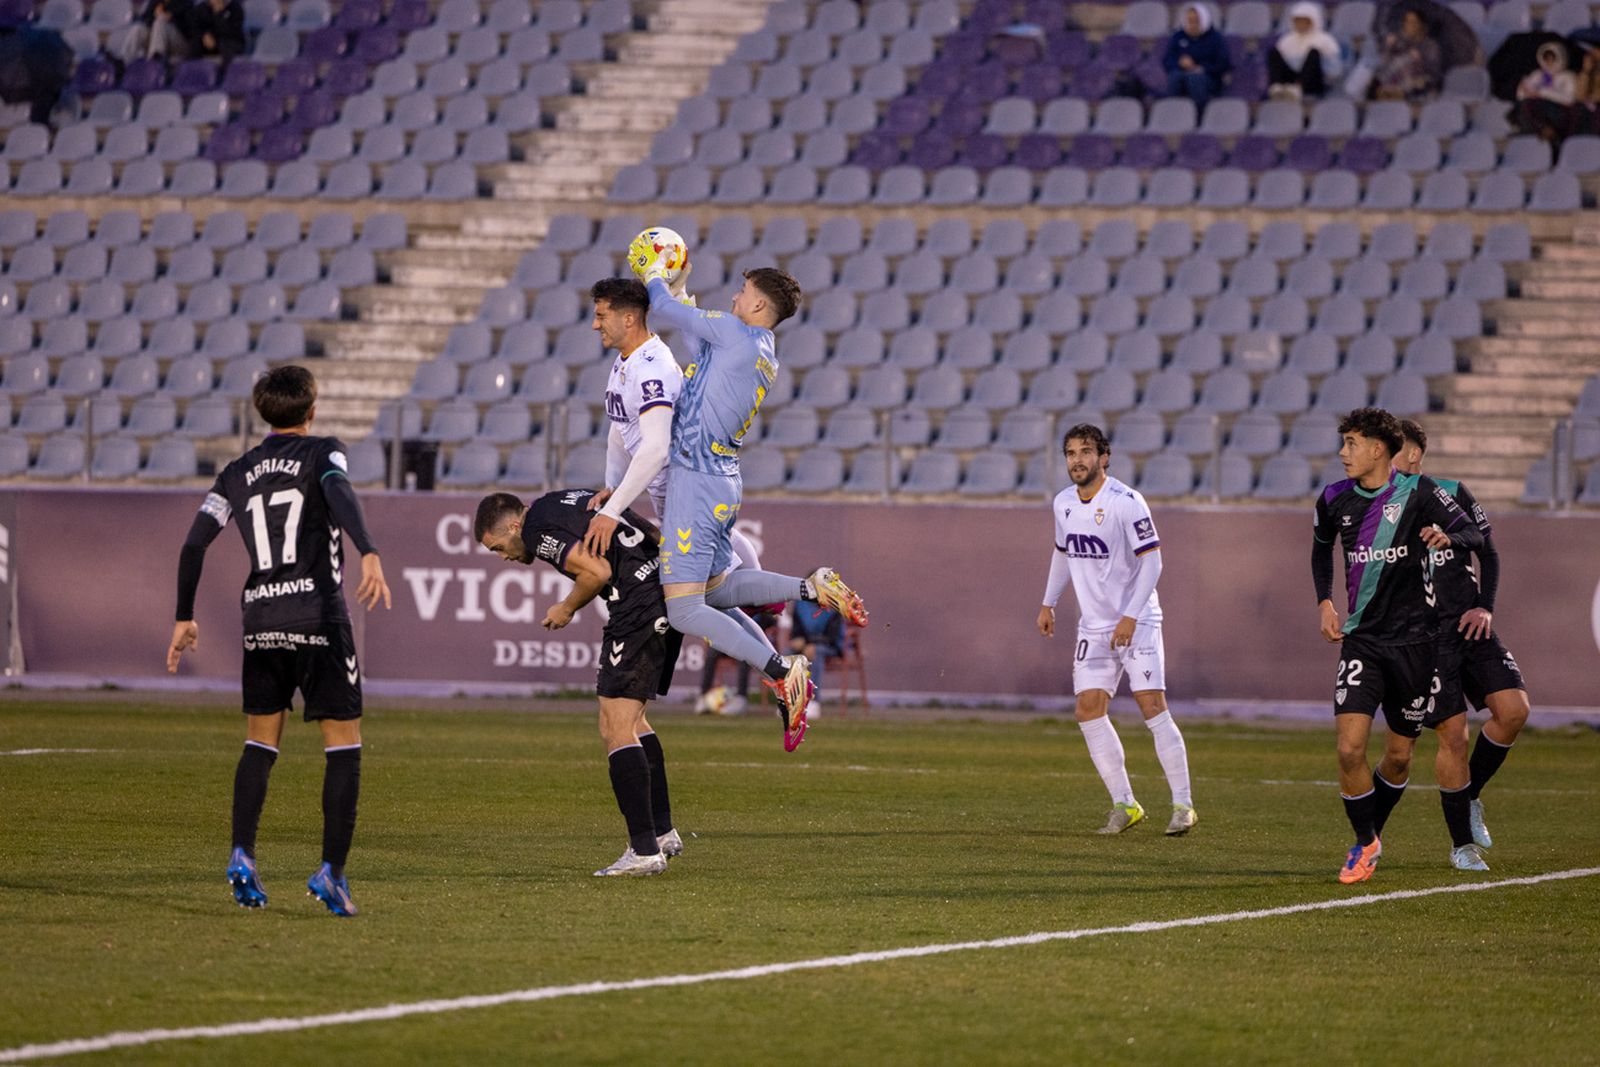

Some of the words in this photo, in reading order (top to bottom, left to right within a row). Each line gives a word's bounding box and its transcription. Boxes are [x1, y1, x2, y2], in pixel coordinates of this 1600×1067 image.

[245, 458, 302, 486] ARRIAZA
[245, 487, 305, 571] 17
[255, 631, 287, 642] COSTA
[287, 633, 308, 645] DEL
[308, 635, 330, 647] SOL
[1336, 659, 1364, 686] 22
